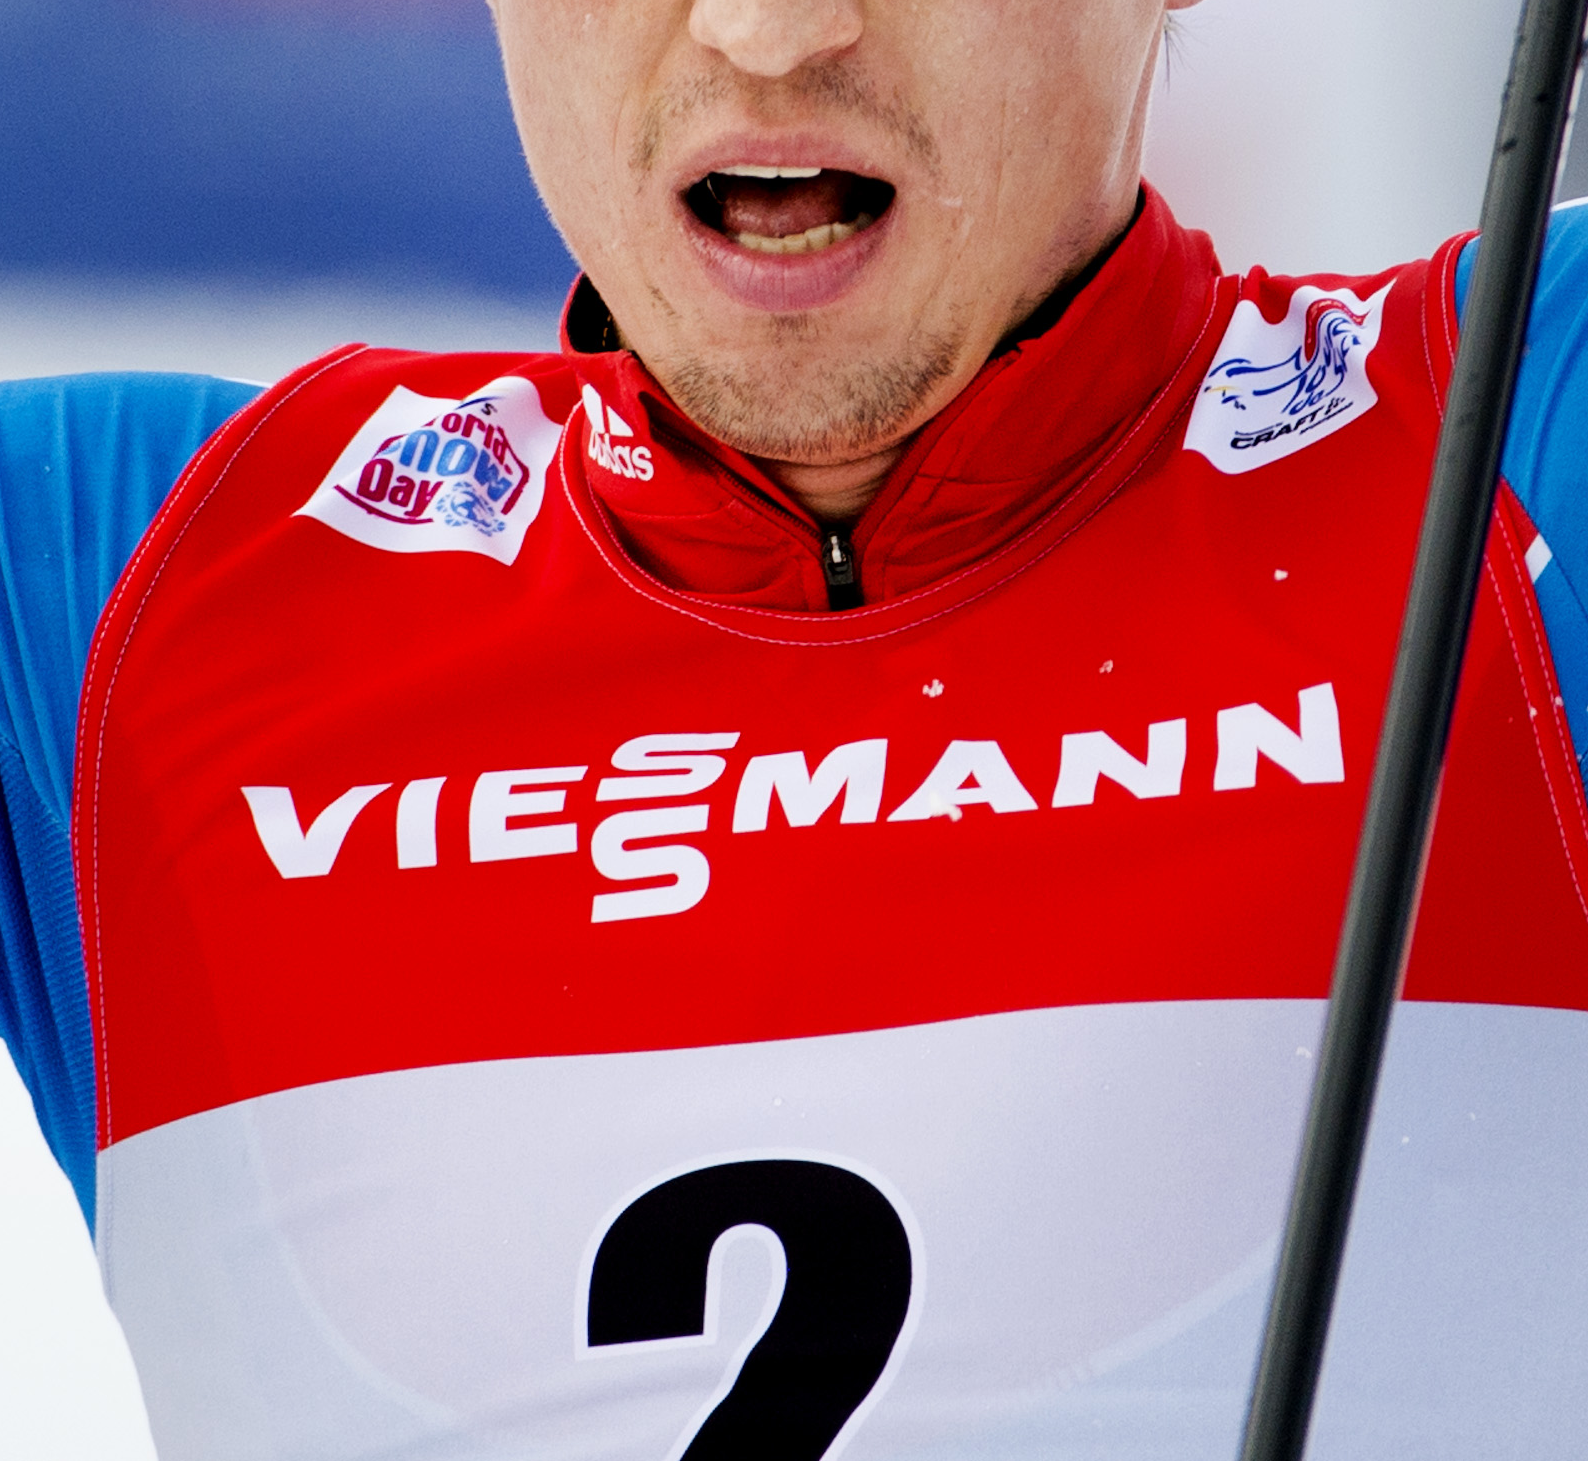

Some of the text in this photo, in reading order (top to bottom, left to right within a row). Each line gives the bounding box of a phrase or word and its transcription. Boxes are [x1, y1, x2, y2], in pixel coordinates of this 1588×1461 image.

[356, 458, 444, 518] Day
[441, 412, 511, 466] orld
[242, 682, 1345, 924] VIESSMANN
[583, 1156, 915, 1461] 2
